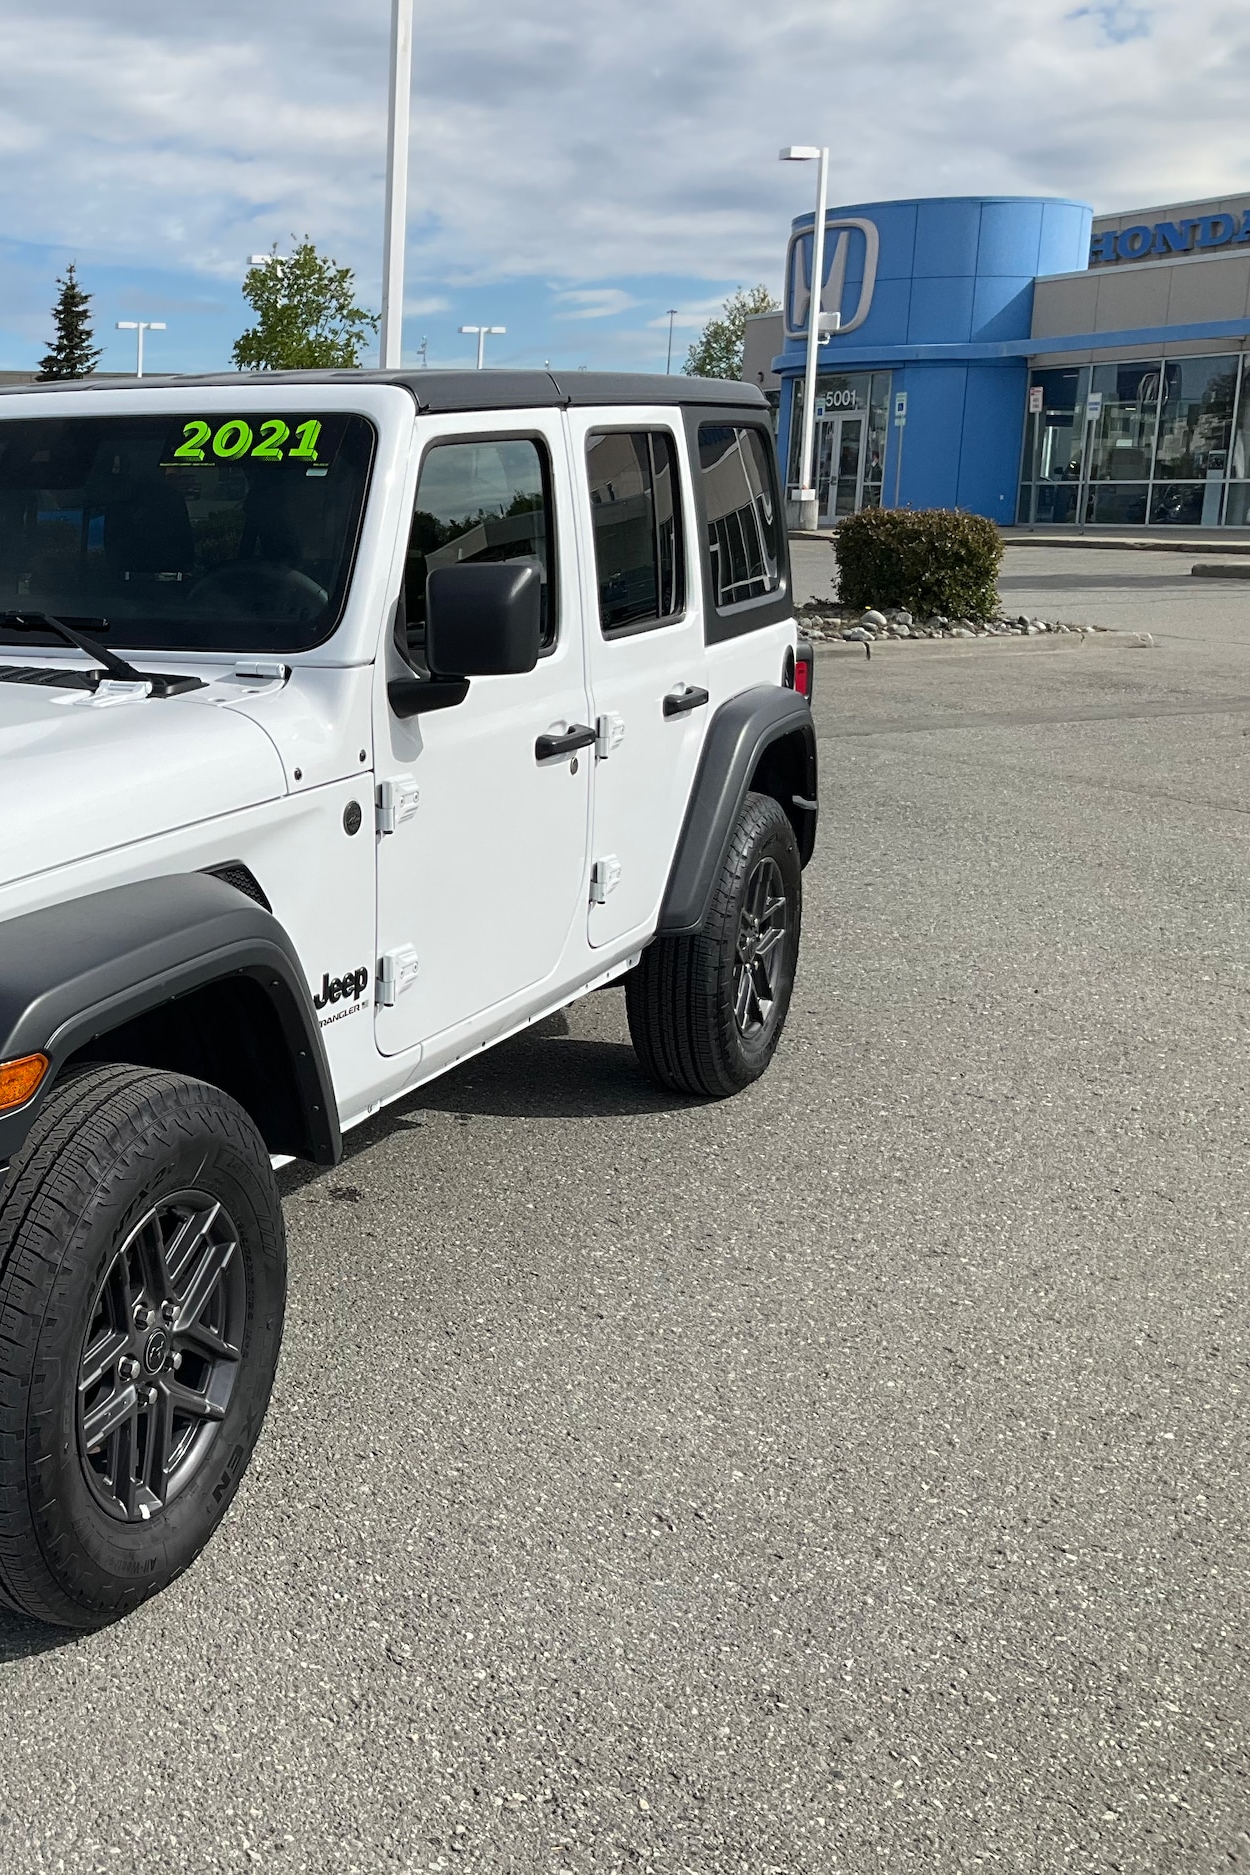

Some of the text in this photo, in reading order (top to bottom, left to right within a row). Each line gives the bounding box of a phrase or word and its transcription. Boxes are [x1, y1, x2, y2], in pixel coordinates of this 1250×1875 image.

[825, 389, 857, 407] 5001
[174, 420, 322, 461] 2021
[313, 966, 368, 1010] Jeep
[318, 1003, 361, 1028] RANGLER
